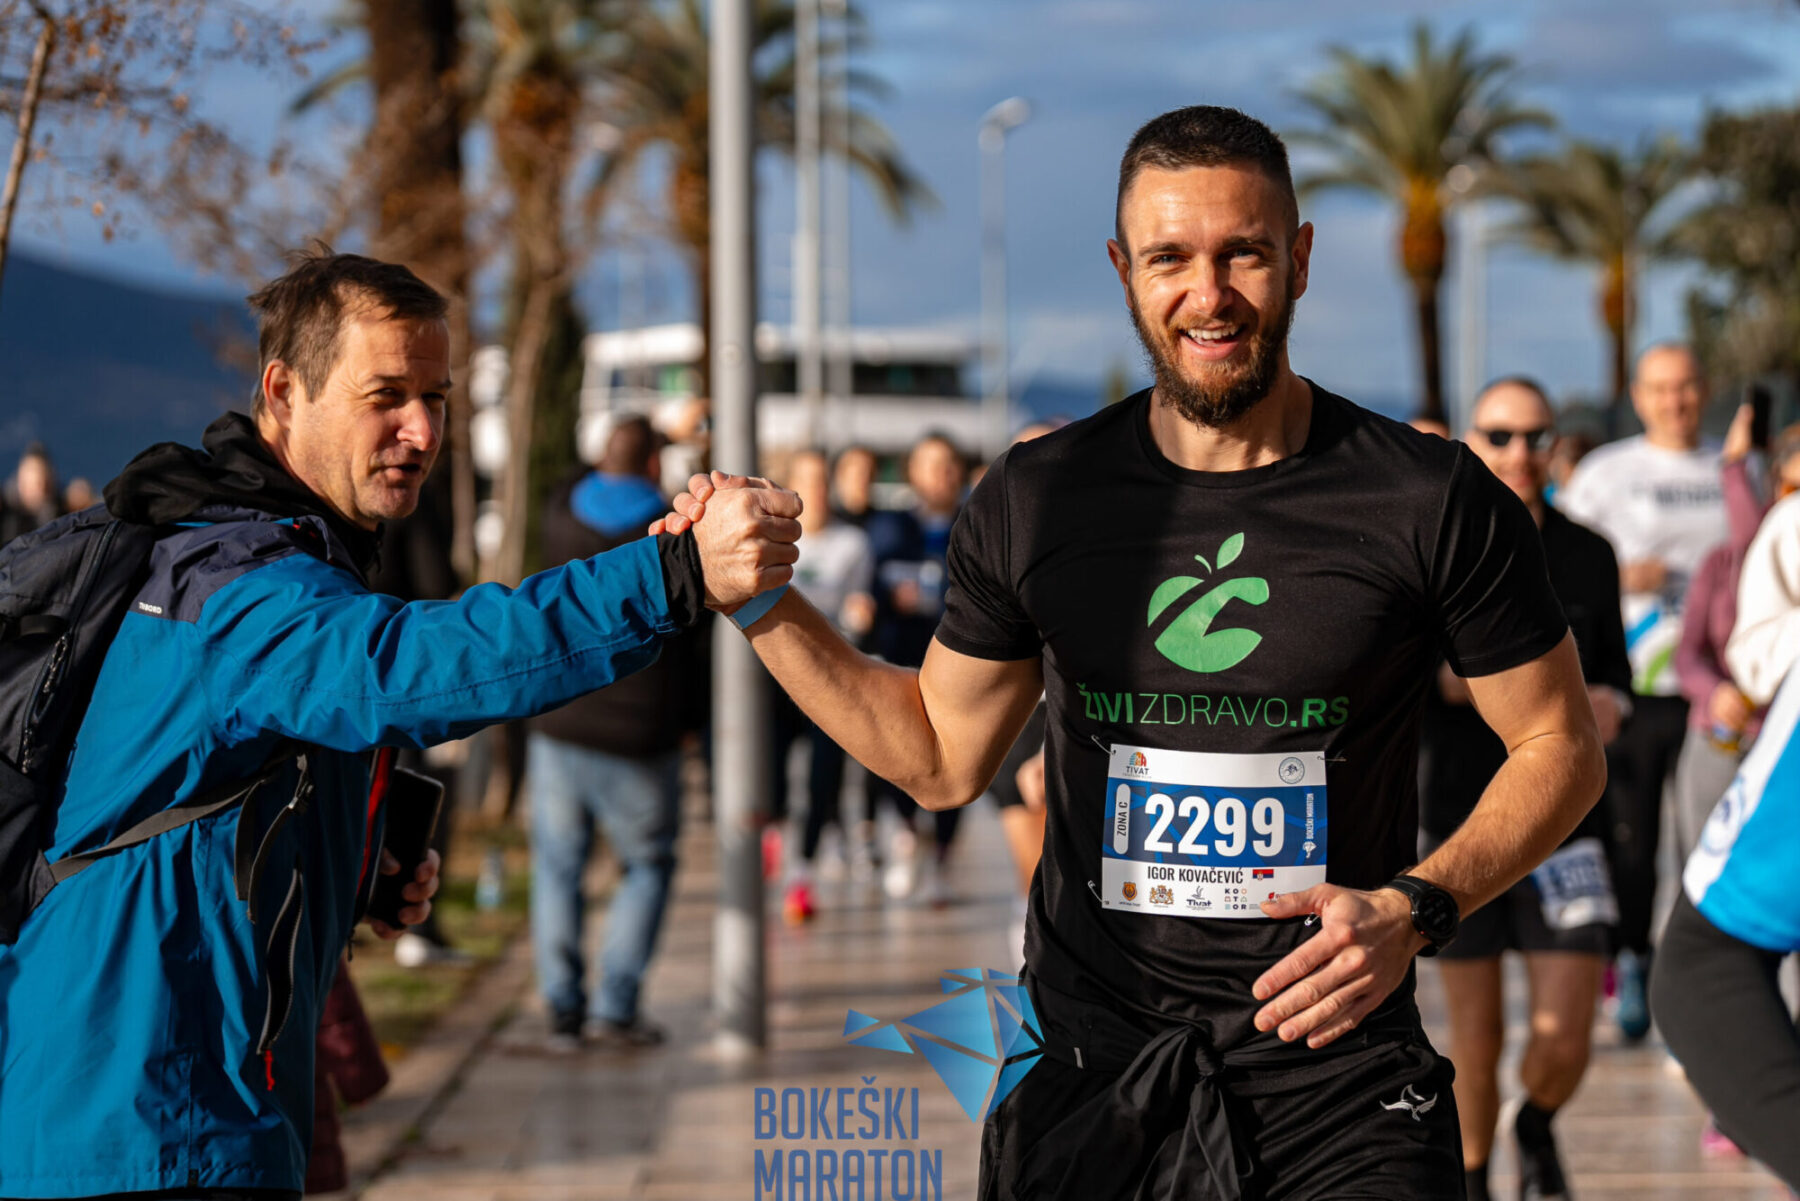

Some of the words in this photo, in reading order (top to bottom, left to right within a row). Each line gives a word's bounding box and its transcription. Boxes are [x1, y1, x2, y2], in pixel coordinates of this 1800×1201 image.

[1126, 765, 1150, 775] TIVAT
[1118, 801, 1128, 809] C
[1116, 811, 1127, 837] ZONA
[1144, 793, 1285, 857] 2299
[1147, 866, 1175, 880] IGOR
[1179, 866, 1243, 884] KOVAČEVIĆ
